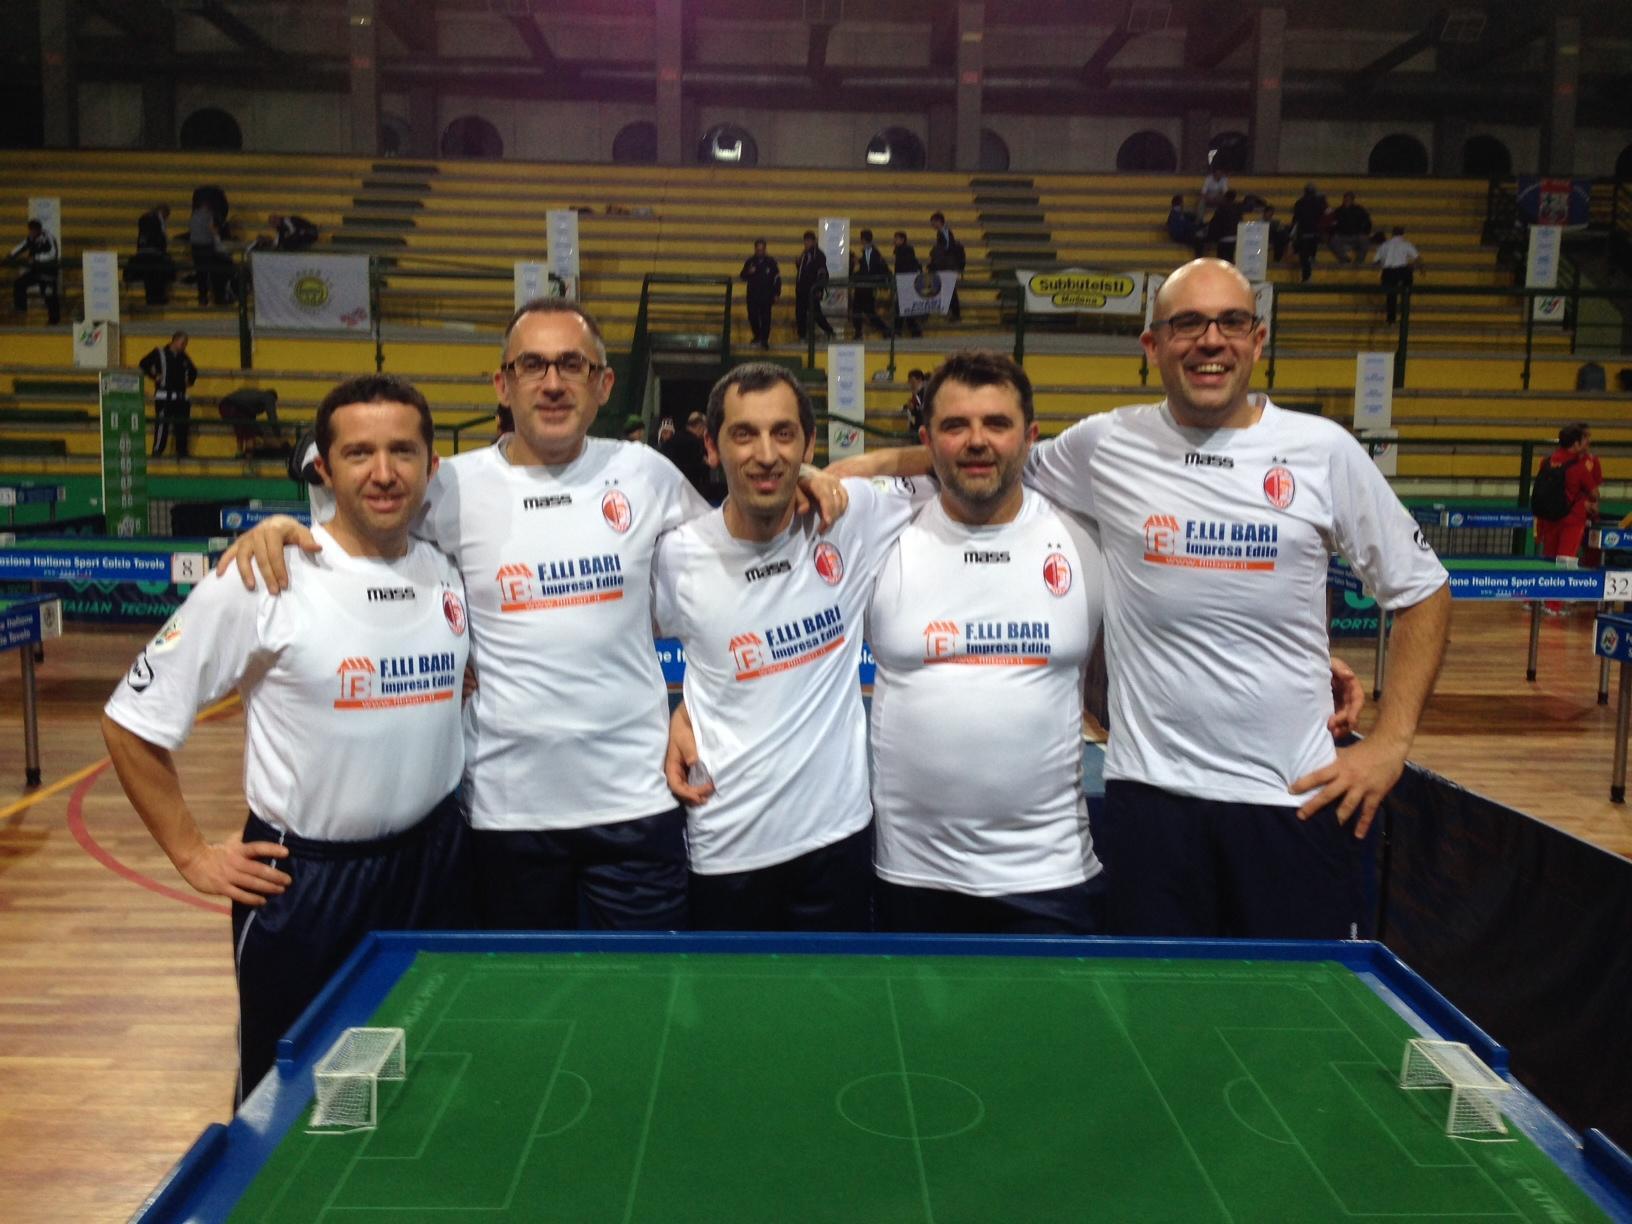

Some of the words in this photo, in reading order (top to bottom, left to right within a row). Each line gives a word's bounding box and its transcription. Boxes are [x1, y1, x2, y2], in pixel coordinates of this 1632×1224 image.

[1039, 277, 1124, 293] Subbuteisti
[1184, 452, 1234, 468] mass
[523, 493, 572, 510] mass
[1185, 520, 1225, 541] F.LLI
[1231, 522, 1278, 543] BARI
[964, 550, 1011, 564] mass
[1185, 542, 1242, 558] Impresa
[1245, 544, 1278, 558] Edile
[33, 555, 71, 568] Italiana
[74, 556, 99, 569] Sport
[102, 556, 131, 568] Calcio
[134, 557, 165, 569] Tavolo
[537, 560, 575, 582] F.LLI
[579, 553, 622, 577] BARI
[745, 559, 791, 583] mass
[541, 579, 593, 596] Impresa
[596, 575, 624, 589] Edile
[1472, 575, 1508, 587] Italiana
[1511, 576, 1536, 588] Sport
[1538, 576, 1566, 587] Calcio
[1568, 576, 1598, 588] Tavolo
[1607, 577, 1629, 596] 32
[366, 587, 415, 602] mass
[765, 621, 801, 648] F.LLI
[802, 605, 841, 634] BARI
[965, 622, 1001, 641] F.LLI
[1007, 622, 1050, 640] BARI
[771, 637, 820, 660] Impresa
[821, 623, 845, 642] Edile
[966, 642, 1018, 656] Impresa
[1021, 641, 1051, 655] Edile
[380, 655, 414, 678] F.LLI
[418, 652, 455, 675] BARI
[381, 677, 430, 695] Impresa
[432, 675, 455, 689] Edile
